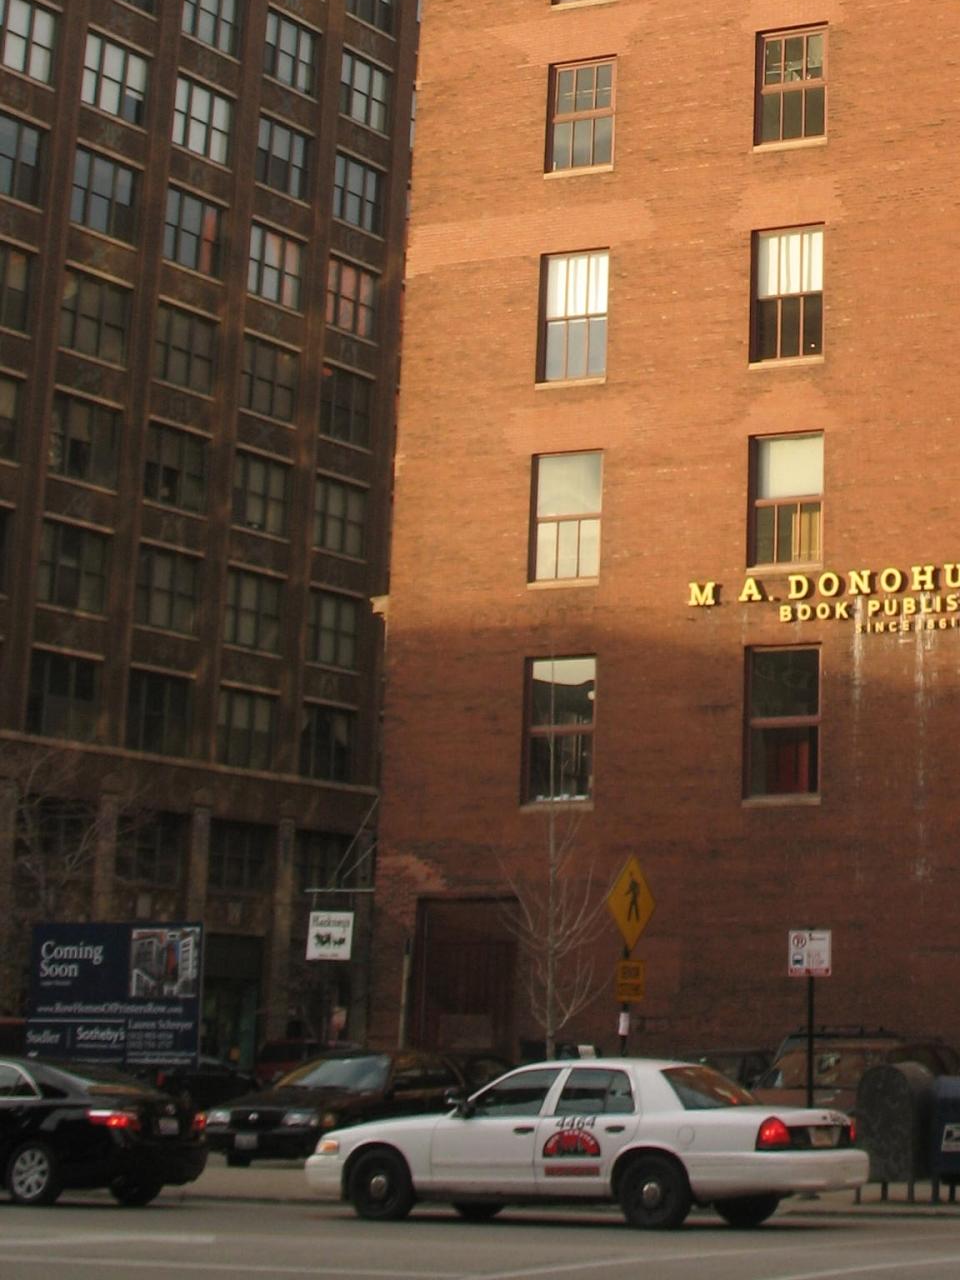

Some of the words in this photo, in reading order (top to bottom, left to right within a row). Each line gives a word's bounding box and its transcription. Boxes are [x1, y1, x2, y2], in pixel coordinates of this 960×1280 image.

[688, 582, 716, 606] M
[739, 578, 774, 602] A.
[779, 602, 849, 622] BOOK
[855, 619, 910, 634] SINCE
[41, 941, 104, 965] Coming
[40, 960, 79, 977] Soon
[76, 1026, 126, 1045] Sotheby's
[556, 1115, 597, 1131] 4464
